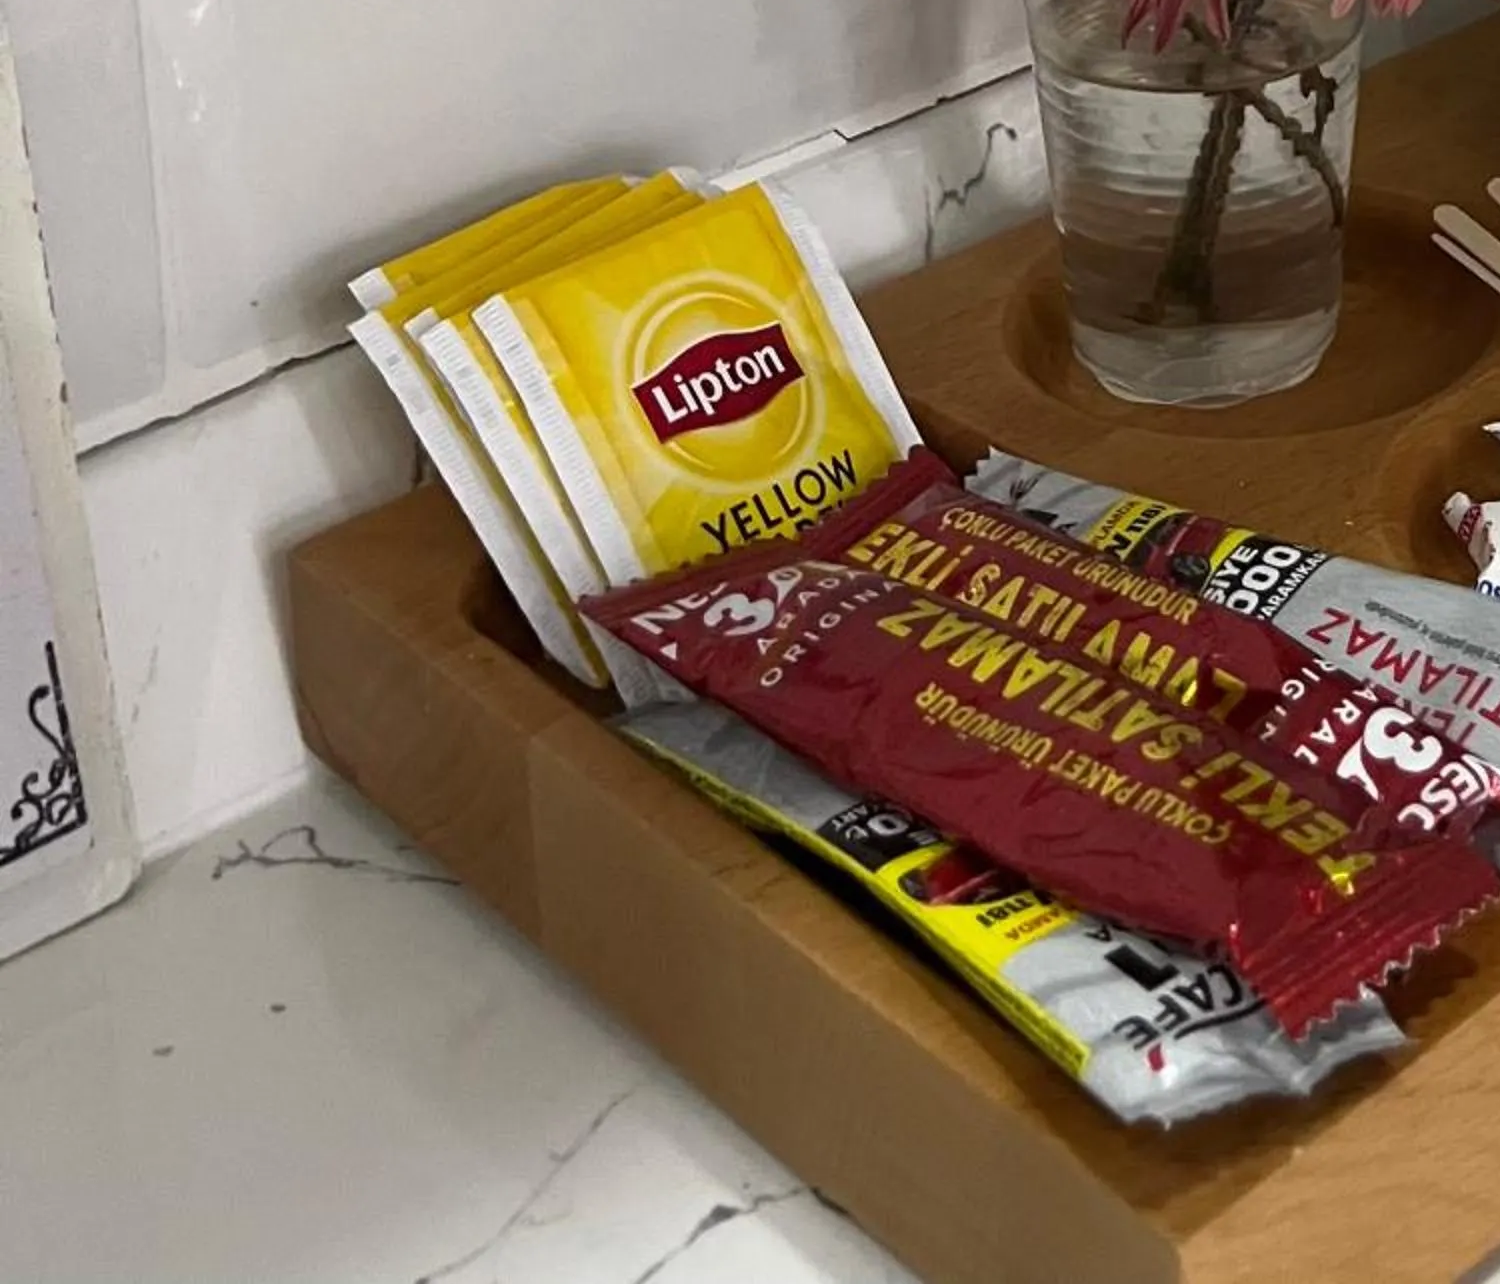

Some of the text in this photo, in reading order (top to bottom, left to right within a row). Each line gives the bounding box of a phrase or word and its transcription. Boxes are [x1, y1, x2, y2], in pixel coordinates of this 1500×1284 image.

[651, 344, 786, 424] Lipton
[701, 449, 857, 554] YELLOW
[1004, 527, 1081, 569] PAKET
[873, 593, 1203, 763] SATILAMAZ
[913, 680, 1234, 843] ÇOKLU PAKET ÜRÜNÜDÜR
